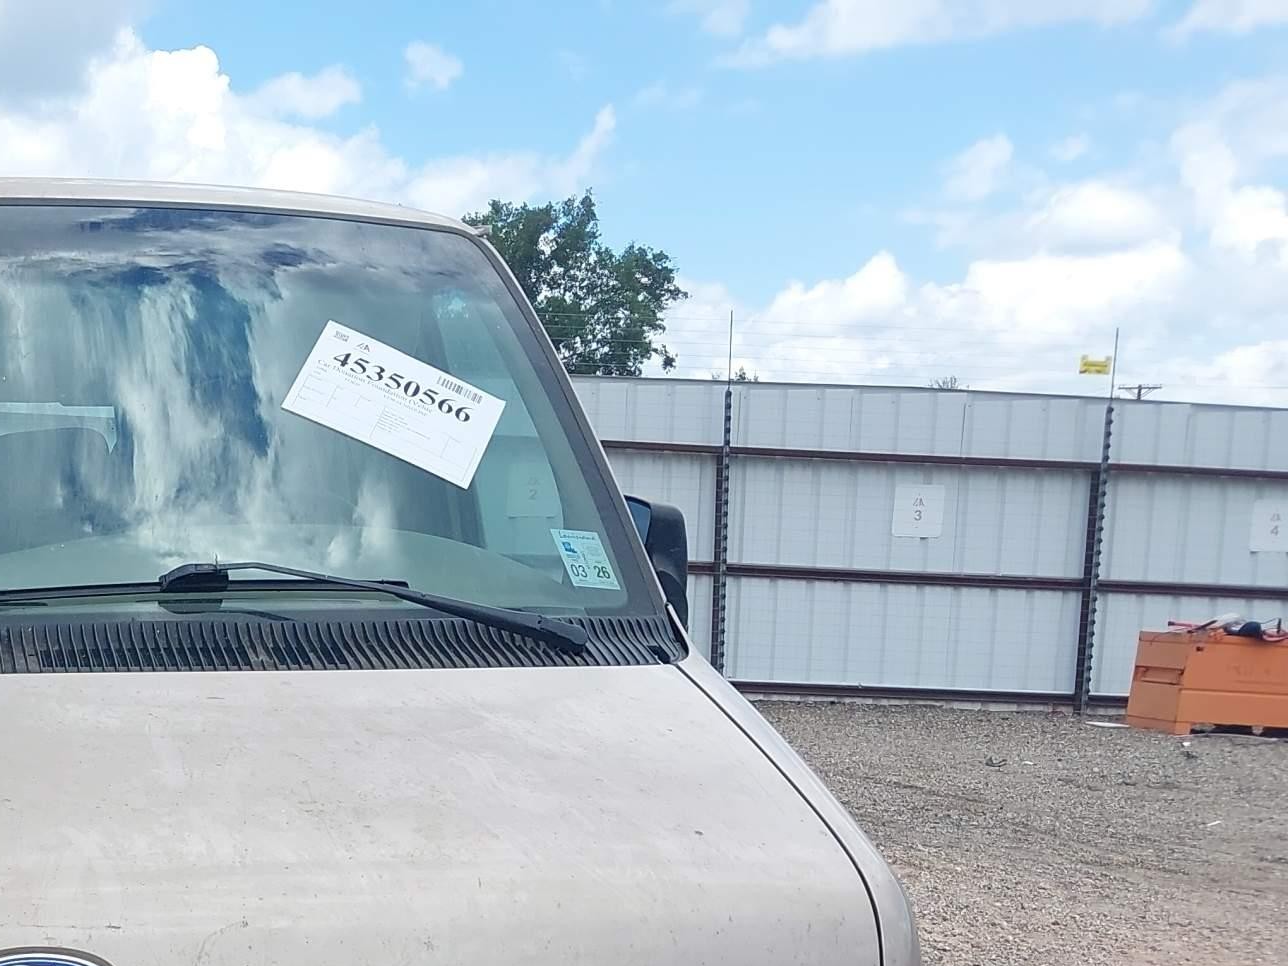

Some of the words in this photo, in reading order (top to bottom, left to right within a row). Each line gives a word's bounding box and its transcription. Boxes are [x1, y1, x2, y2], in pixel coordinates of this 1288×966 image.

[331, 352, 472, 423] 45350566
[914, 510, 922, 521] 3
[570, 564, 588, 578] 03
[593, 565, 611, 580] 26
